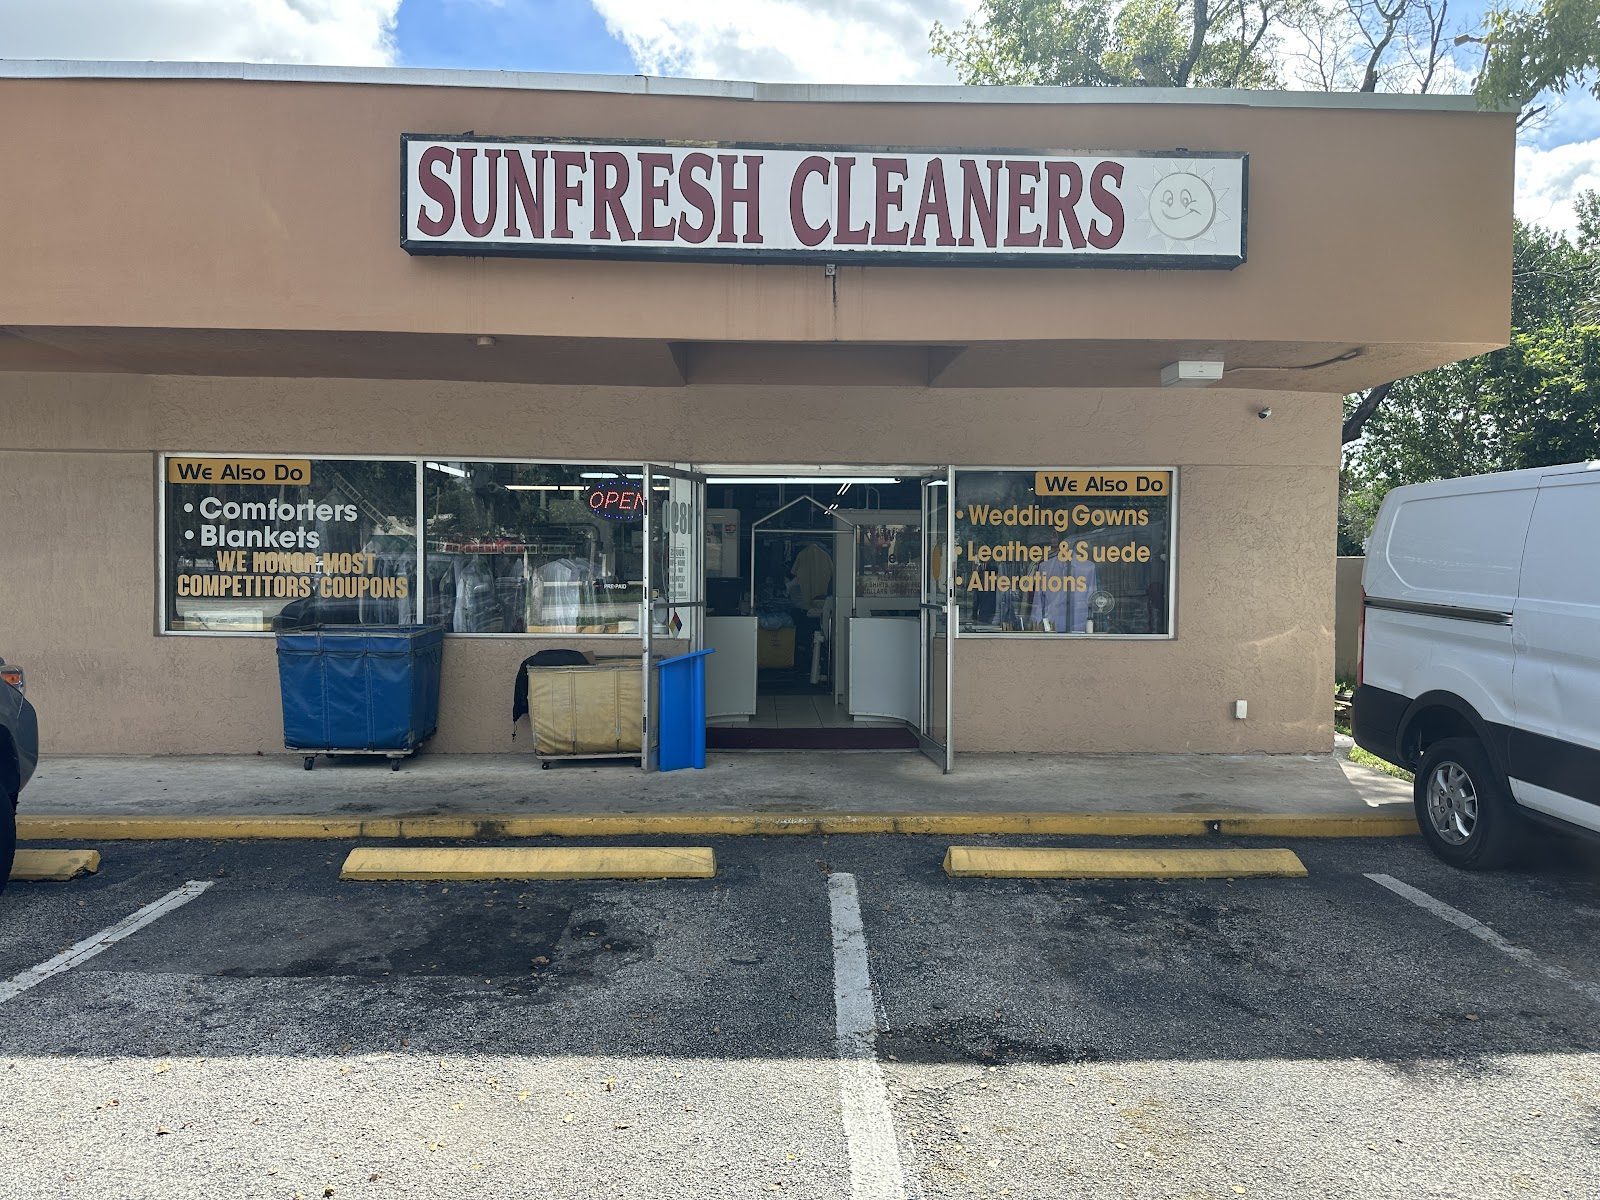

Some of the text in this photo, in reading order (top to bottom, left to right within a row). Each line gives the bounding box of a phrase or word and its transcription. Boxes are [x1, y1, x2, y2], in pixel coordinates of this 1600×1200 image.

[417, 145, 1125, 251] SUNFRESH CLEANERS
[177, 463, 303, 481] We Also Do
[1044, 476, 1163, 492] We Also Do
[199, 496, 358, 522] Comforters
[589, 491, 644, 510] OPEN
[968, 504, 1149, 533] Wedding Gowns
[200, 524, 320, 549] Blankets
[217, 550, 376, 574] WE HONOR MOST
[967, 540, 1052, 563] Leather
[1057, 540, 1073, 562] &
[320, 576, 408, 598] COUPONS
[967, 570, 1087, 593] Alterations
